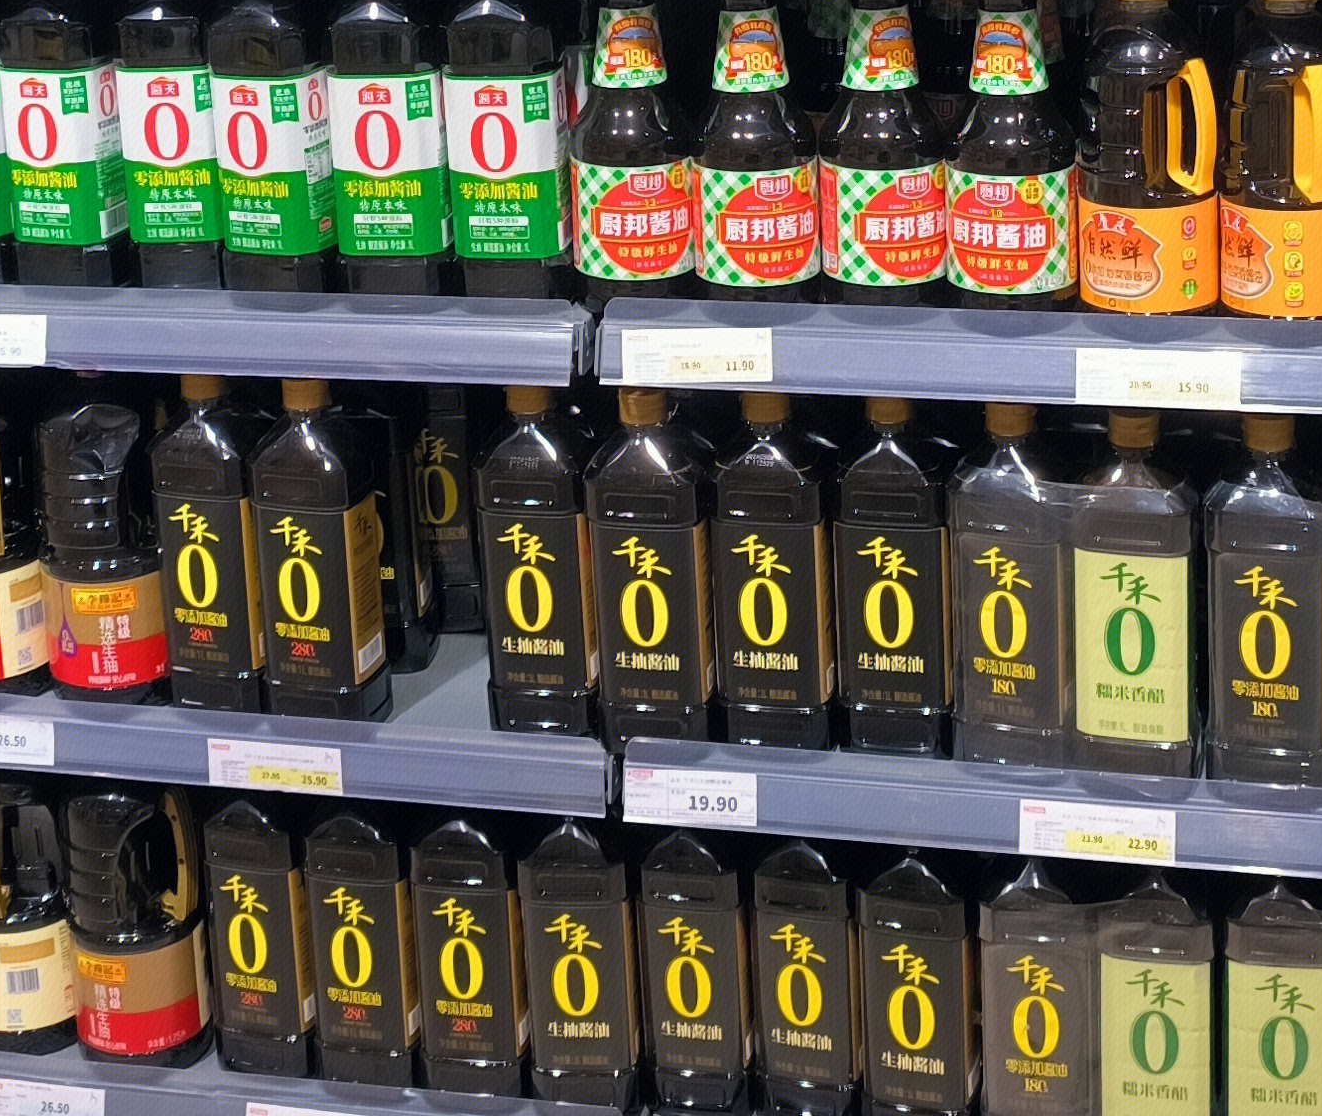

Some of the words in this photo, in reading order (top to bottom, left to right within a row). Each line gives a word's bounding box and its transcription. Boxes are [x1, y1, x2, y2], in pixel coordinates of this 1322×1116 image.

[470, 111, 518, 173] 0
[598, 210, 687, 238] 厨邦酱油
[724, 212, 815, 244] 厨邦酱油
[952, 220, 1047, 250] 厨邦酱油
[725, 360, 755, 373] 11.90
[1177, 381, 1210, 395] 15.90
[168, 504, 219, 544] 千禾
[497, 523, 555, 564] 千禾
[177, 544, 217, 608] 0
[856, 536, 919, 578] 千禾
[506, 566, 553, 632] 0
[1099, 563, 1161, 605] 千禾
[864, 580, 915, 649] 0
[501, 637, 565, 656] 生抽酱油
[1103, 606, 1156, 677] 0
[857, 653, 924, 673] 生抽酱油
[687, 794, 738, 813] 19.90
[1127, 839, 1158, 852] 22.90
[323, 887, 375, 926] 千禾
[544, 914, 602, 953] 千禾
[331, 926, 373, 989] 0
[881, 944, 940, 984] 千禾
[552, 953, 599, 1017] 0
[1254, 974, 1315, 1013] 千禾
[548, 1020, 610, 1040] 生抽酱油
[887, 985, 936, 1051] 0
[881, 1051, 945, 1076] 生抽酱油
[1259, 1015, 1309, 1081] 0
[40, 1101, 70, 1115] 26.50
